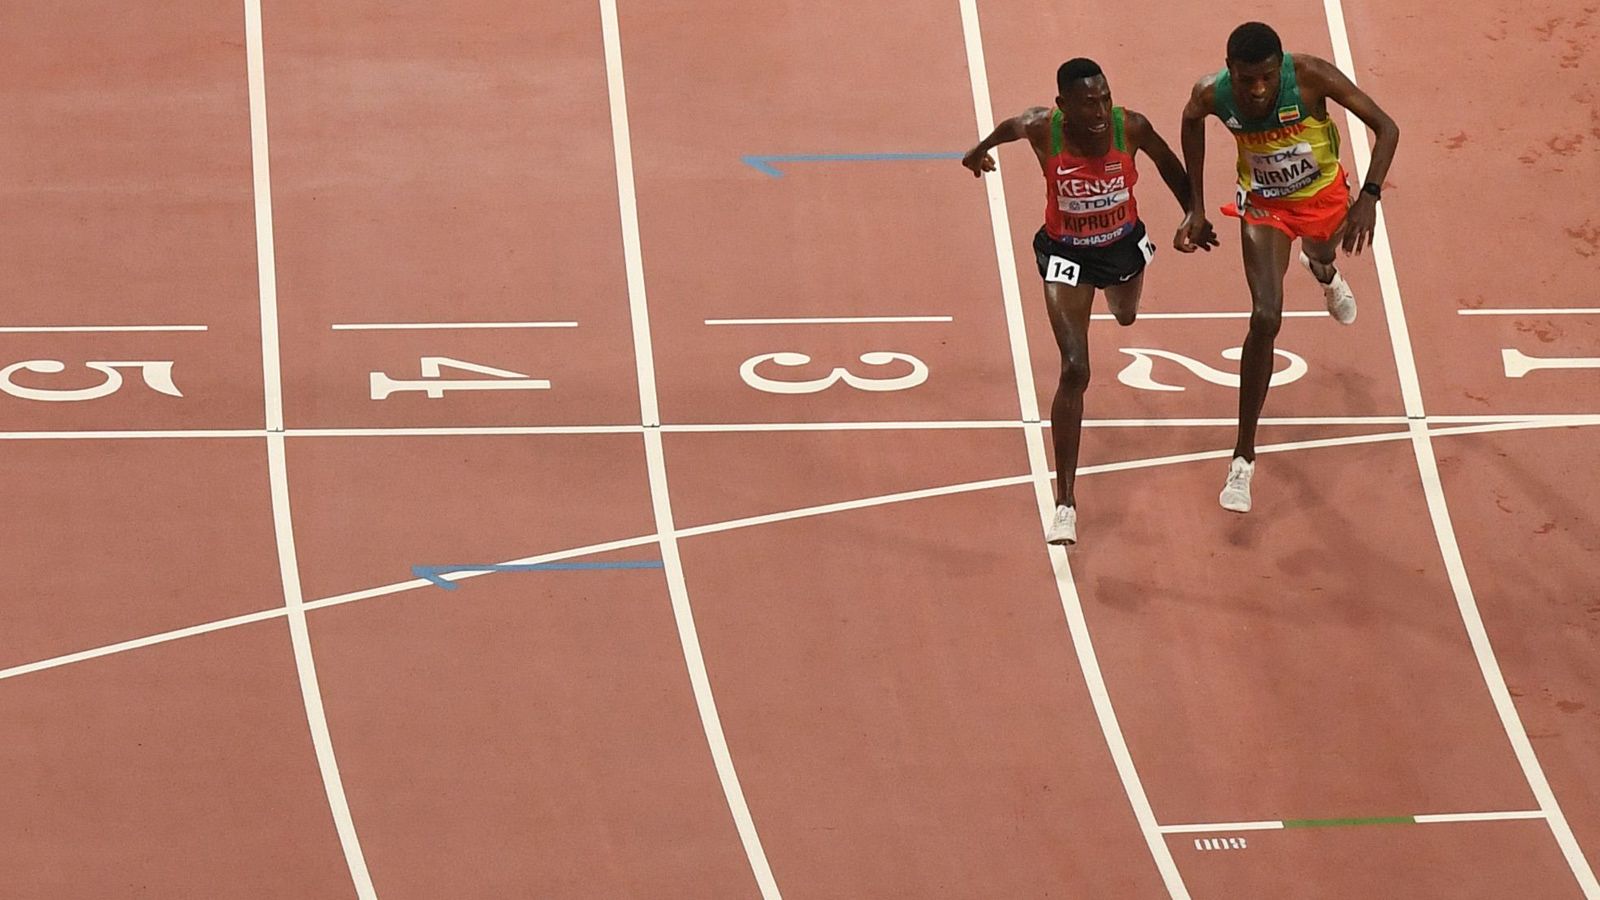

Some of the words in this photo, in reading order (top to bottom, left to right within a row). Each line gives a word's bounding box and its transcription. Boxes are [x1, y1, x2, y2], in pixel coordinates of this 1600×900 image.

[1260, 146, 1298, 164] TDK
[1253, 158, 1313, 185] GIRMA
[1057, 176, 1124, 196] KENYA
[1080, 194, 1118, 210] TDK
[1064, 206, 1126, 232] KIPRUTO
[1073, 227, 1124, 246] DOHA2019
[1054, 262, 1075, 281] 14
[0, 359, 184, 402] 5
[369, 356, 552, 401] 4
[739, 351, 929, 394] 3
[1117, 347, 1308, 391] 2
